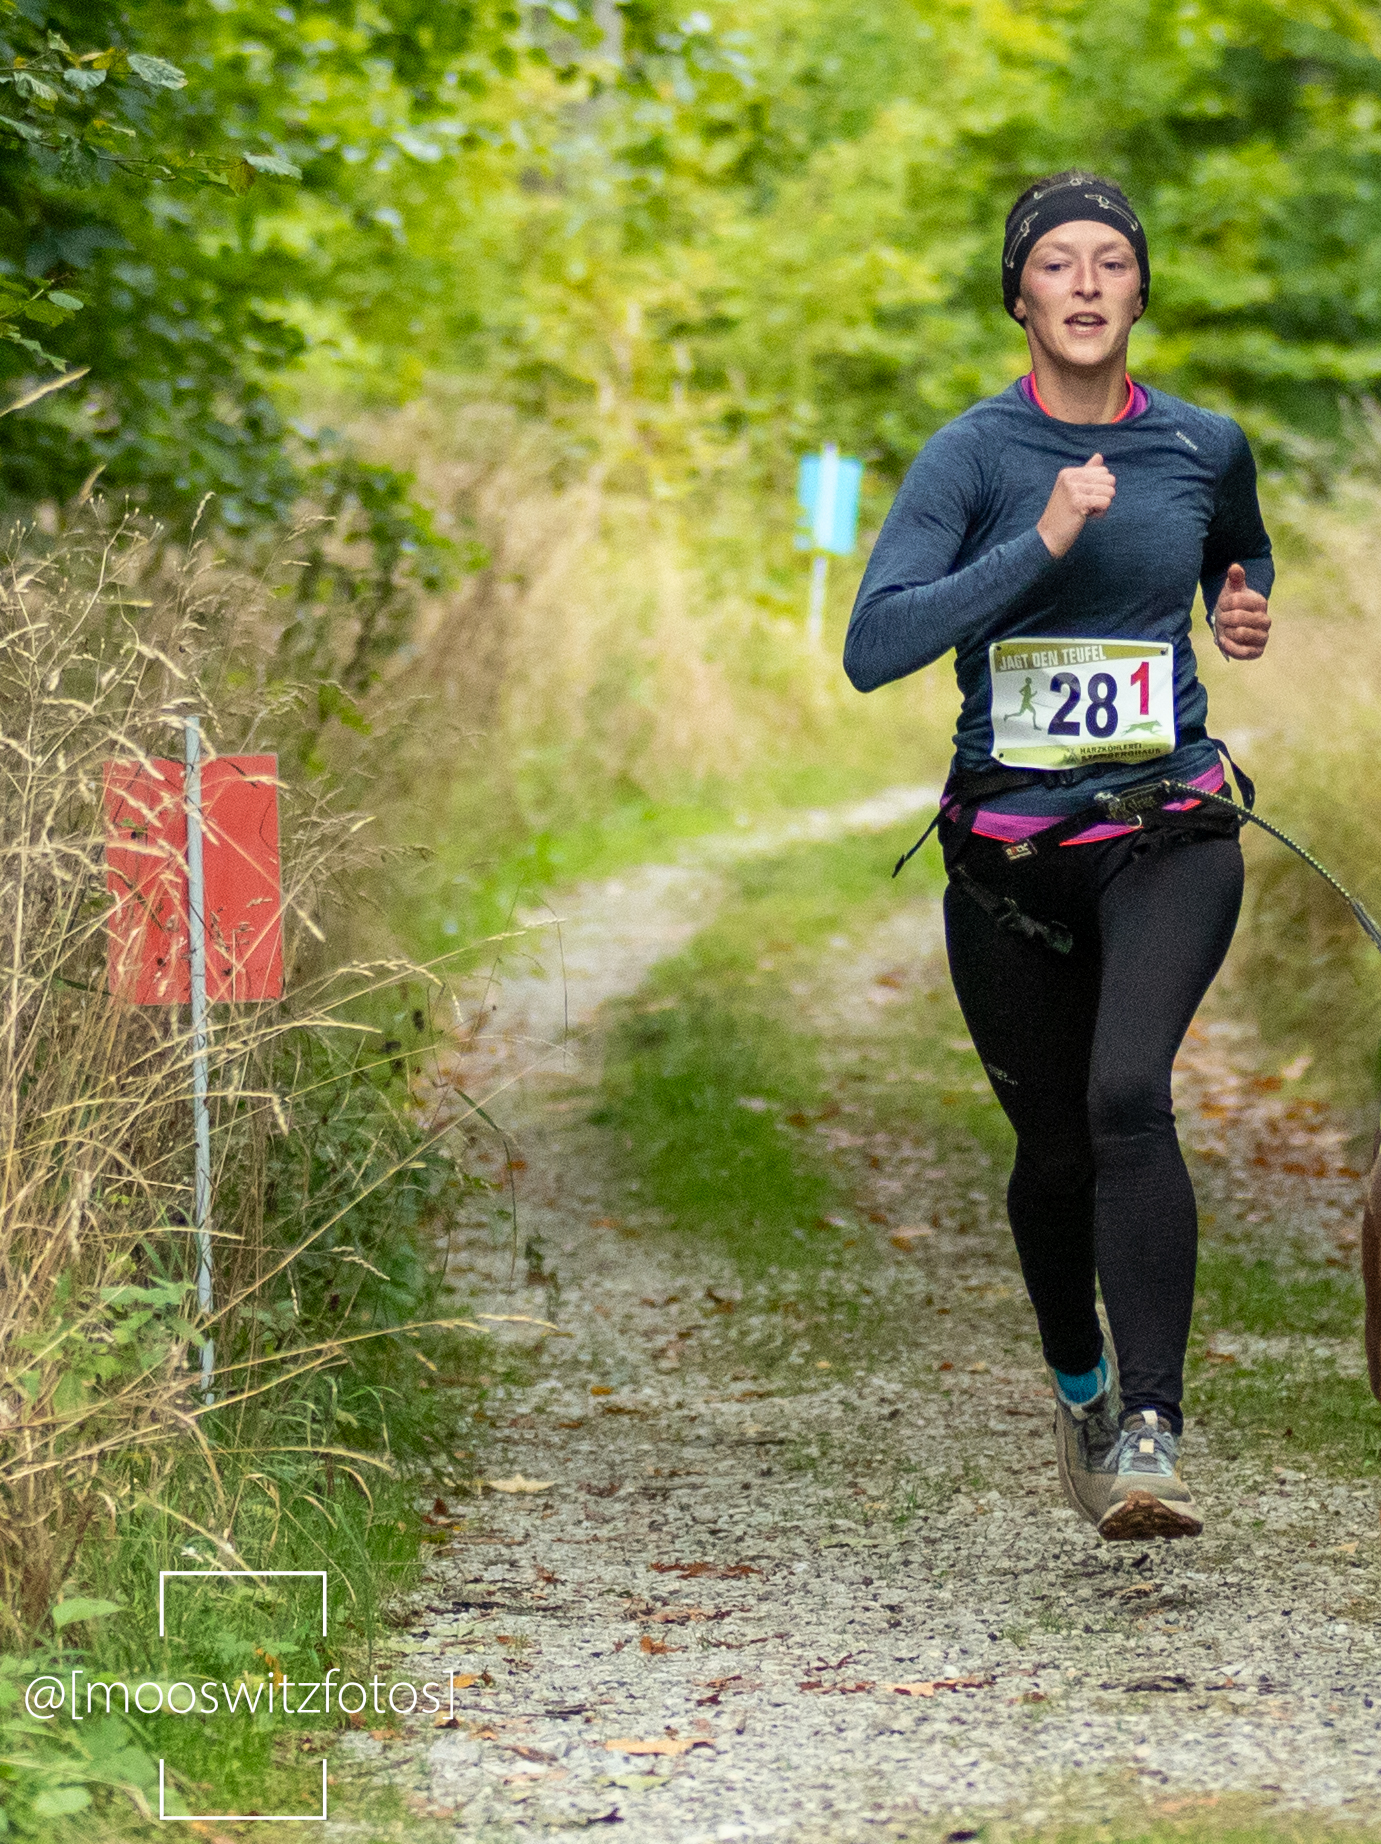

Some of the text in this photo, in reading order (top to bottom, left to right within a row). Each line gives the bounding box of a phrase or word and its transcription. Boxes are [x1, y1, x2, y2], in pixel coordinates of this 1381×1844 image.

[1000, 645, 1107, 671] JAGT DEN TEUFEL
[1047, 672, 1119, 738] 28
